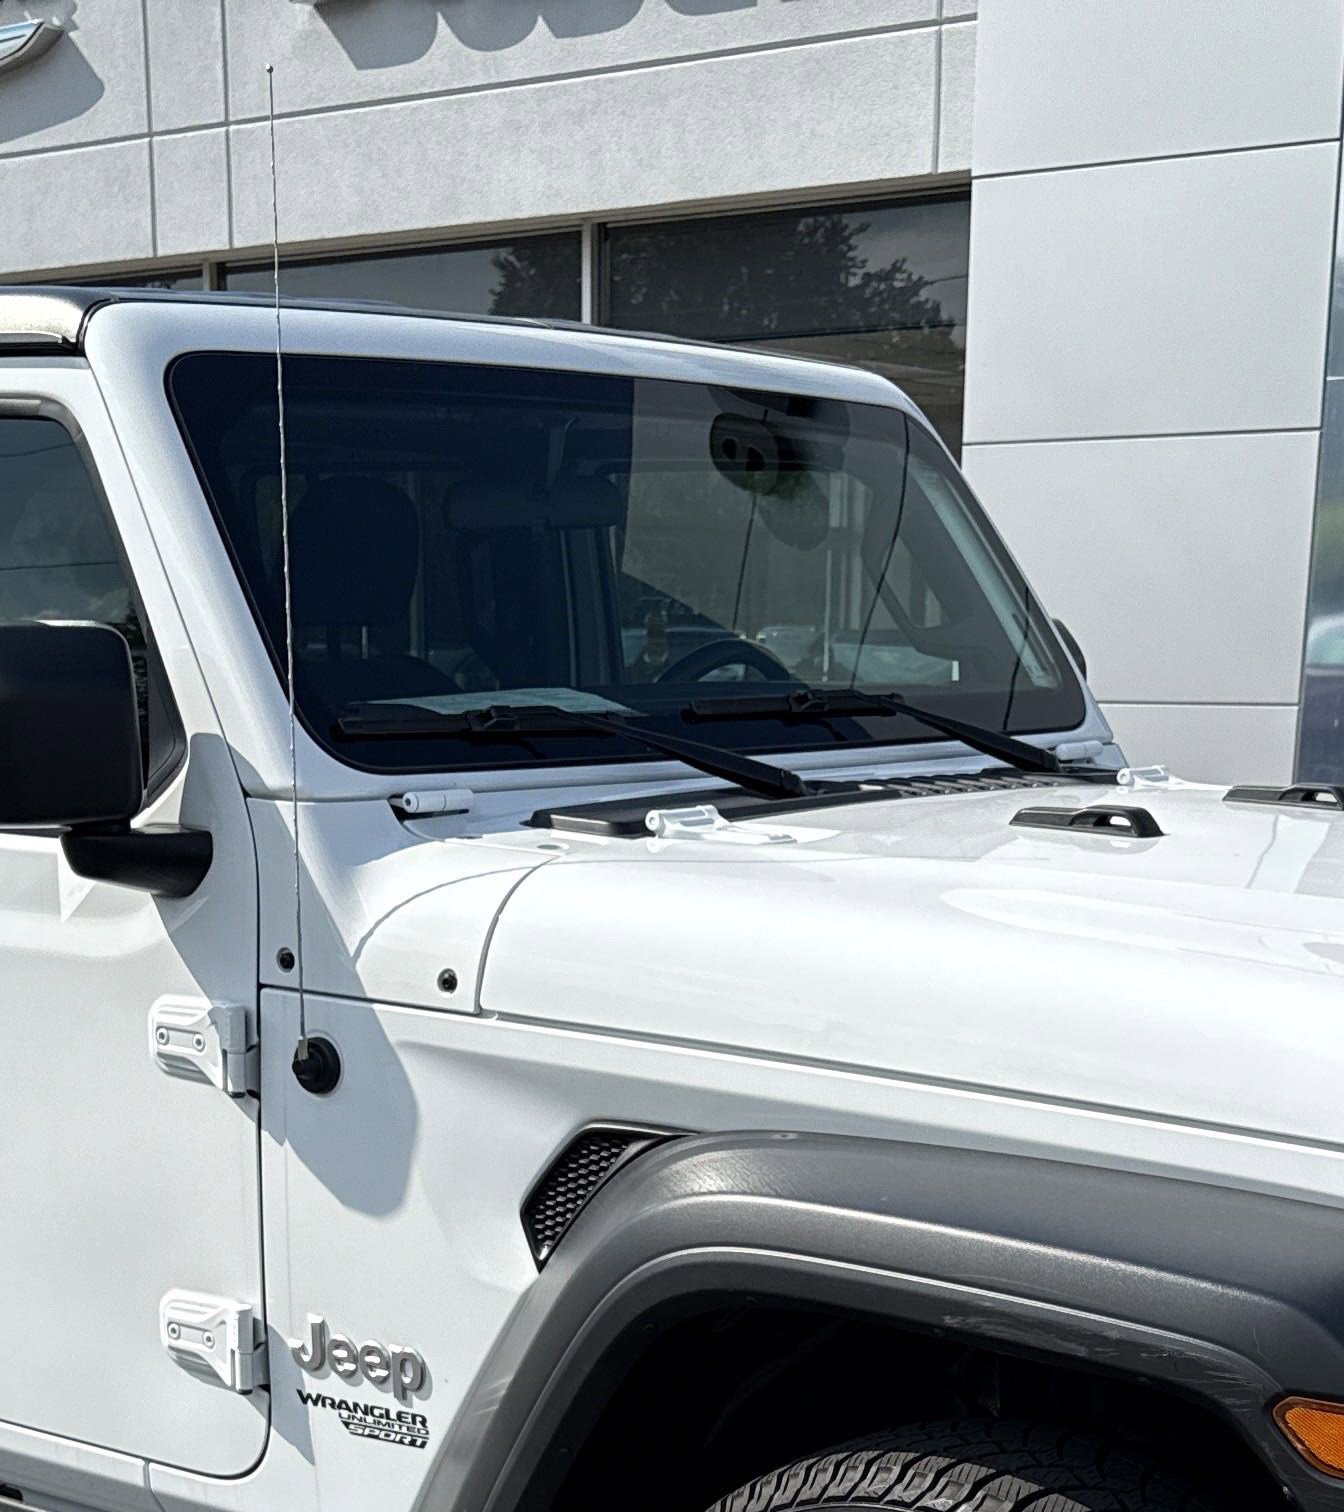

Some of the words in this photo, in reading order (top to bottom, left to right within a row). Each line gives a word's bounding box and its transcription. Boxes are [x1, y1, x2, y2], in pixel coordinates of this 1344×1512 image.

[289, 1312, 429, 1402] Jeep
[296, 1388, 427, 1428] WRANGLER
[338, 1411, 429, 1436] UNLIMITED
[348, 1423, 428, 1448] SPORT
